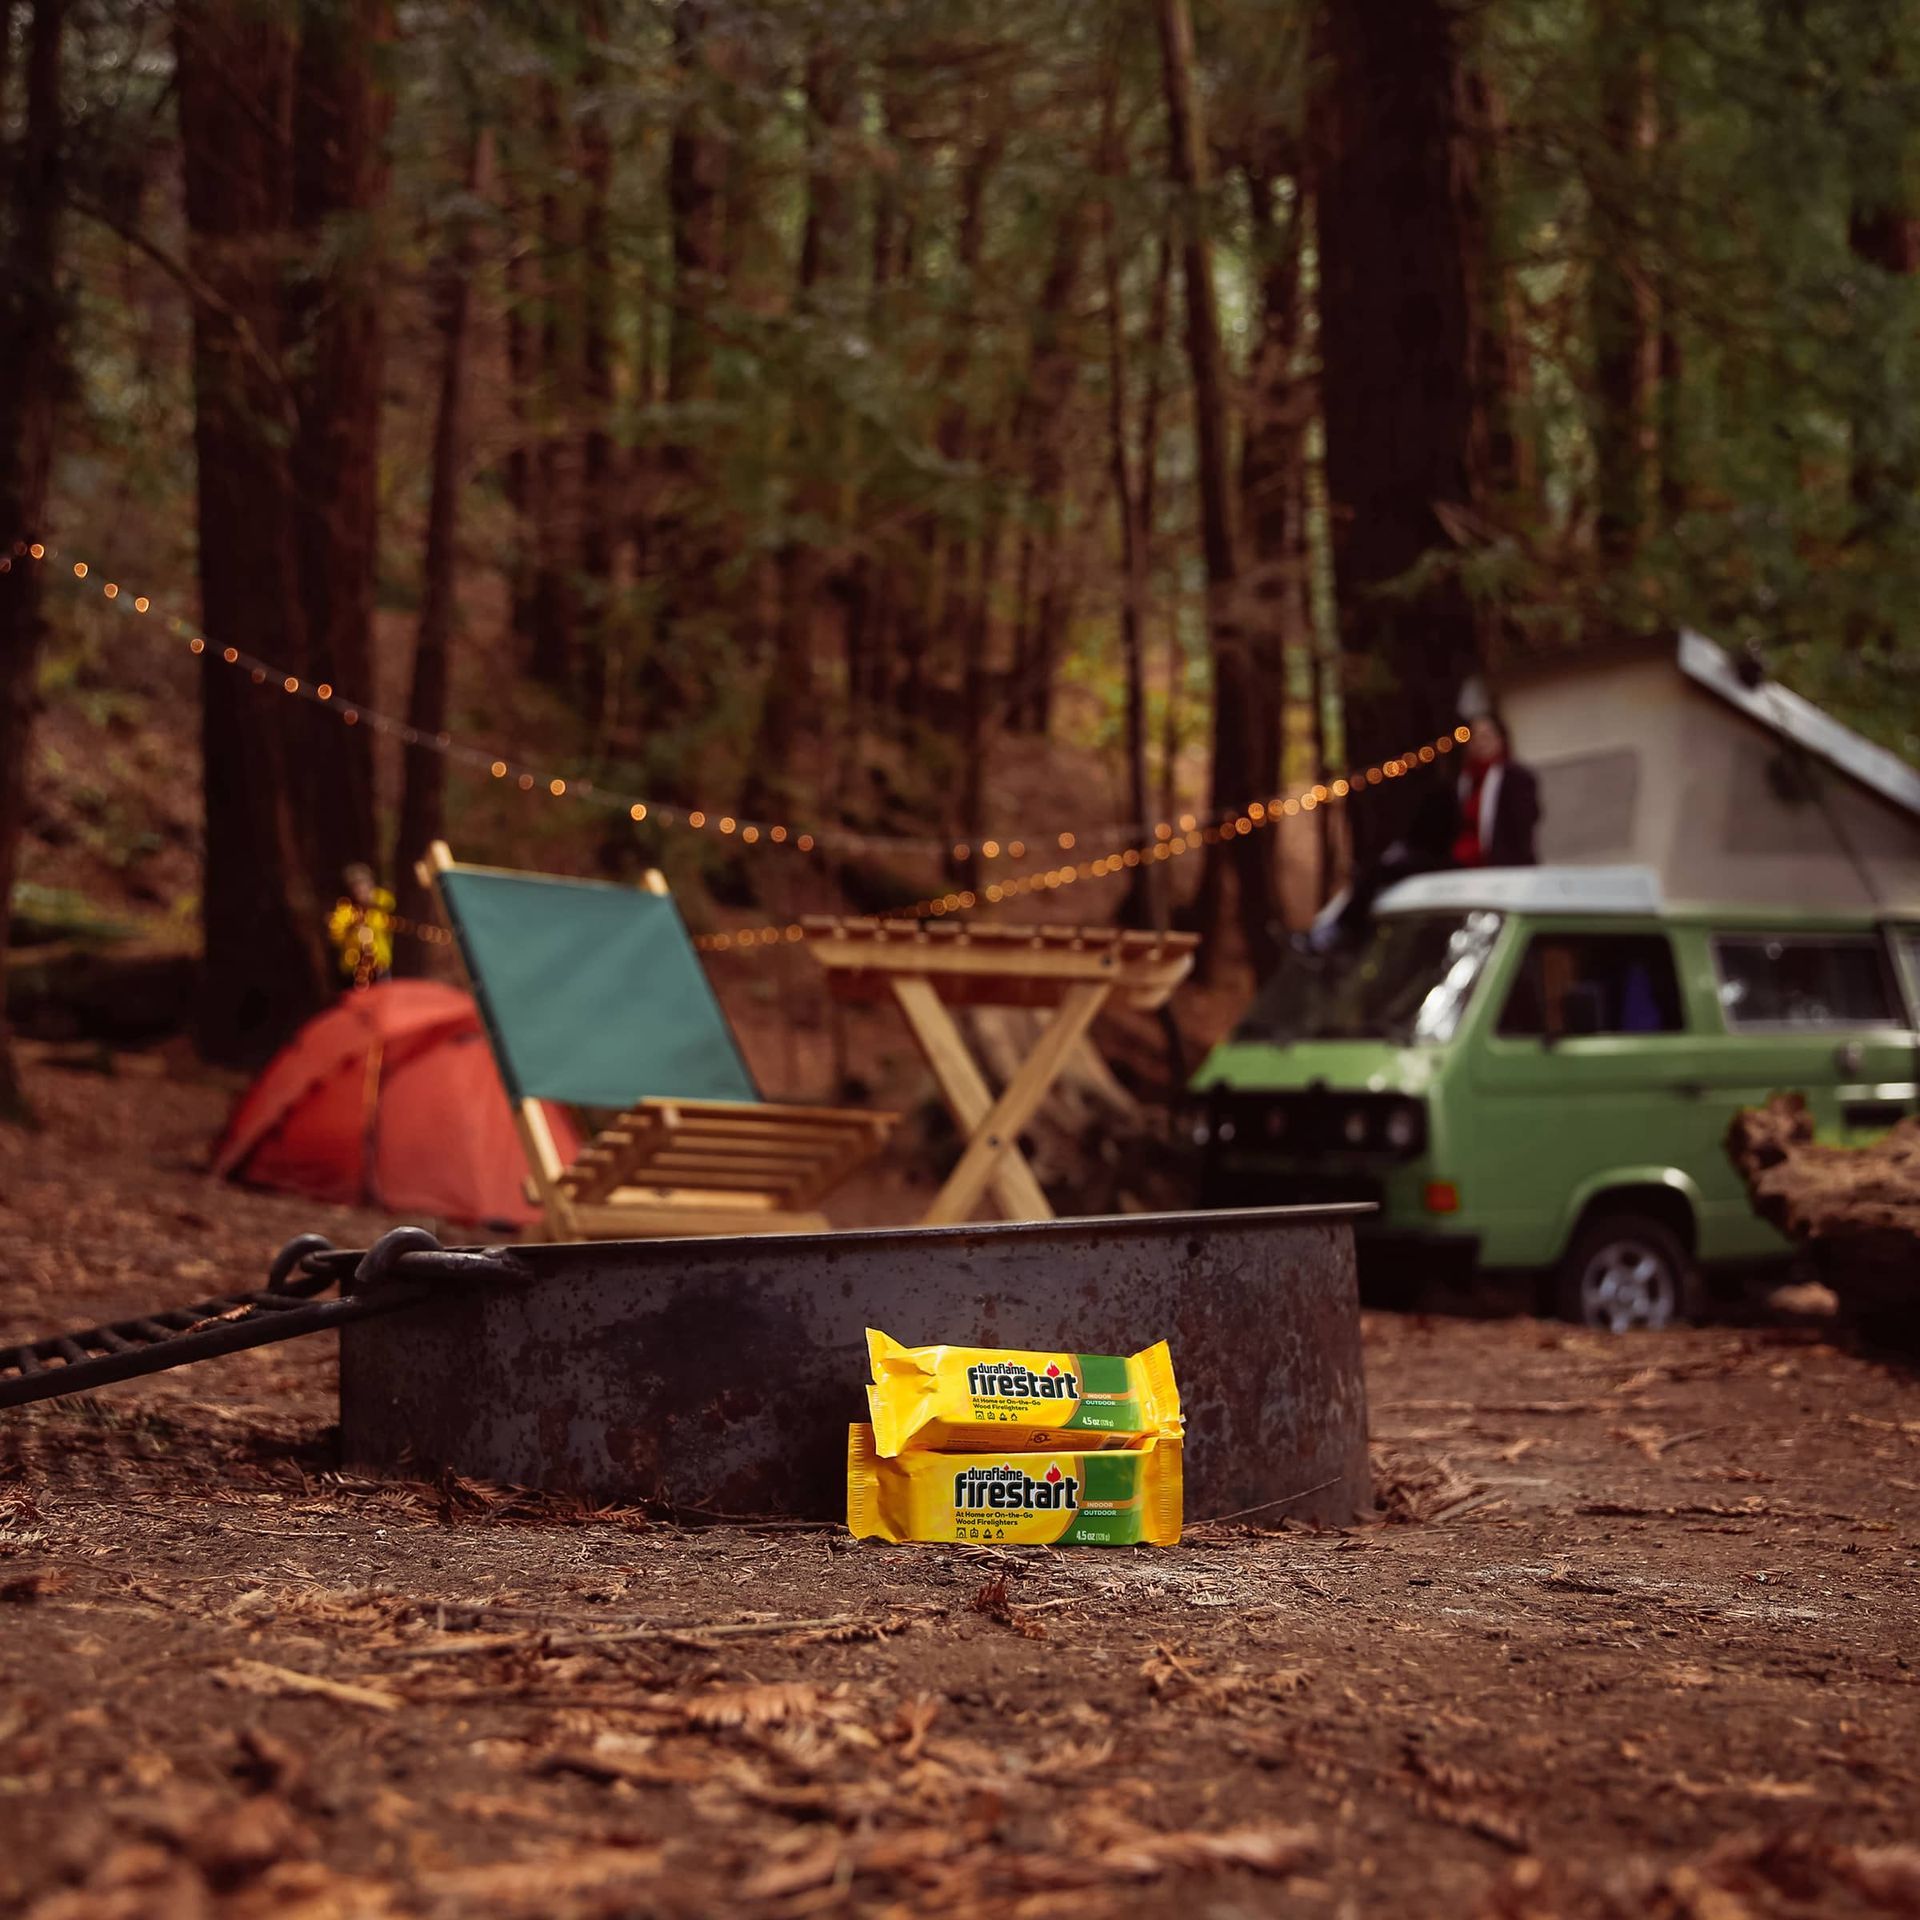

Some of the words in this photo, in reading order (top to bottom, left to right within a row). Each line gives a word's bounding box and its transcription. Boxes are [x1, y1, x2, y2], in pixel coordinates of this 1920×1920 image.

[978, 1363, 1026, 1375] duraflame
[967, 1367, 1078, 1399] firestart
[1082, 1416, 1092, 1425] 4.5
[968, 1467, 1023, 1480] duraflame
[955, 1473, 1078, 1509] firestart
[977, 1518, 1018, 1526] Firelighters
[1076, 1530, 1087, 1541] 4.5
[1087, 1533, 1095, 1541] oz
